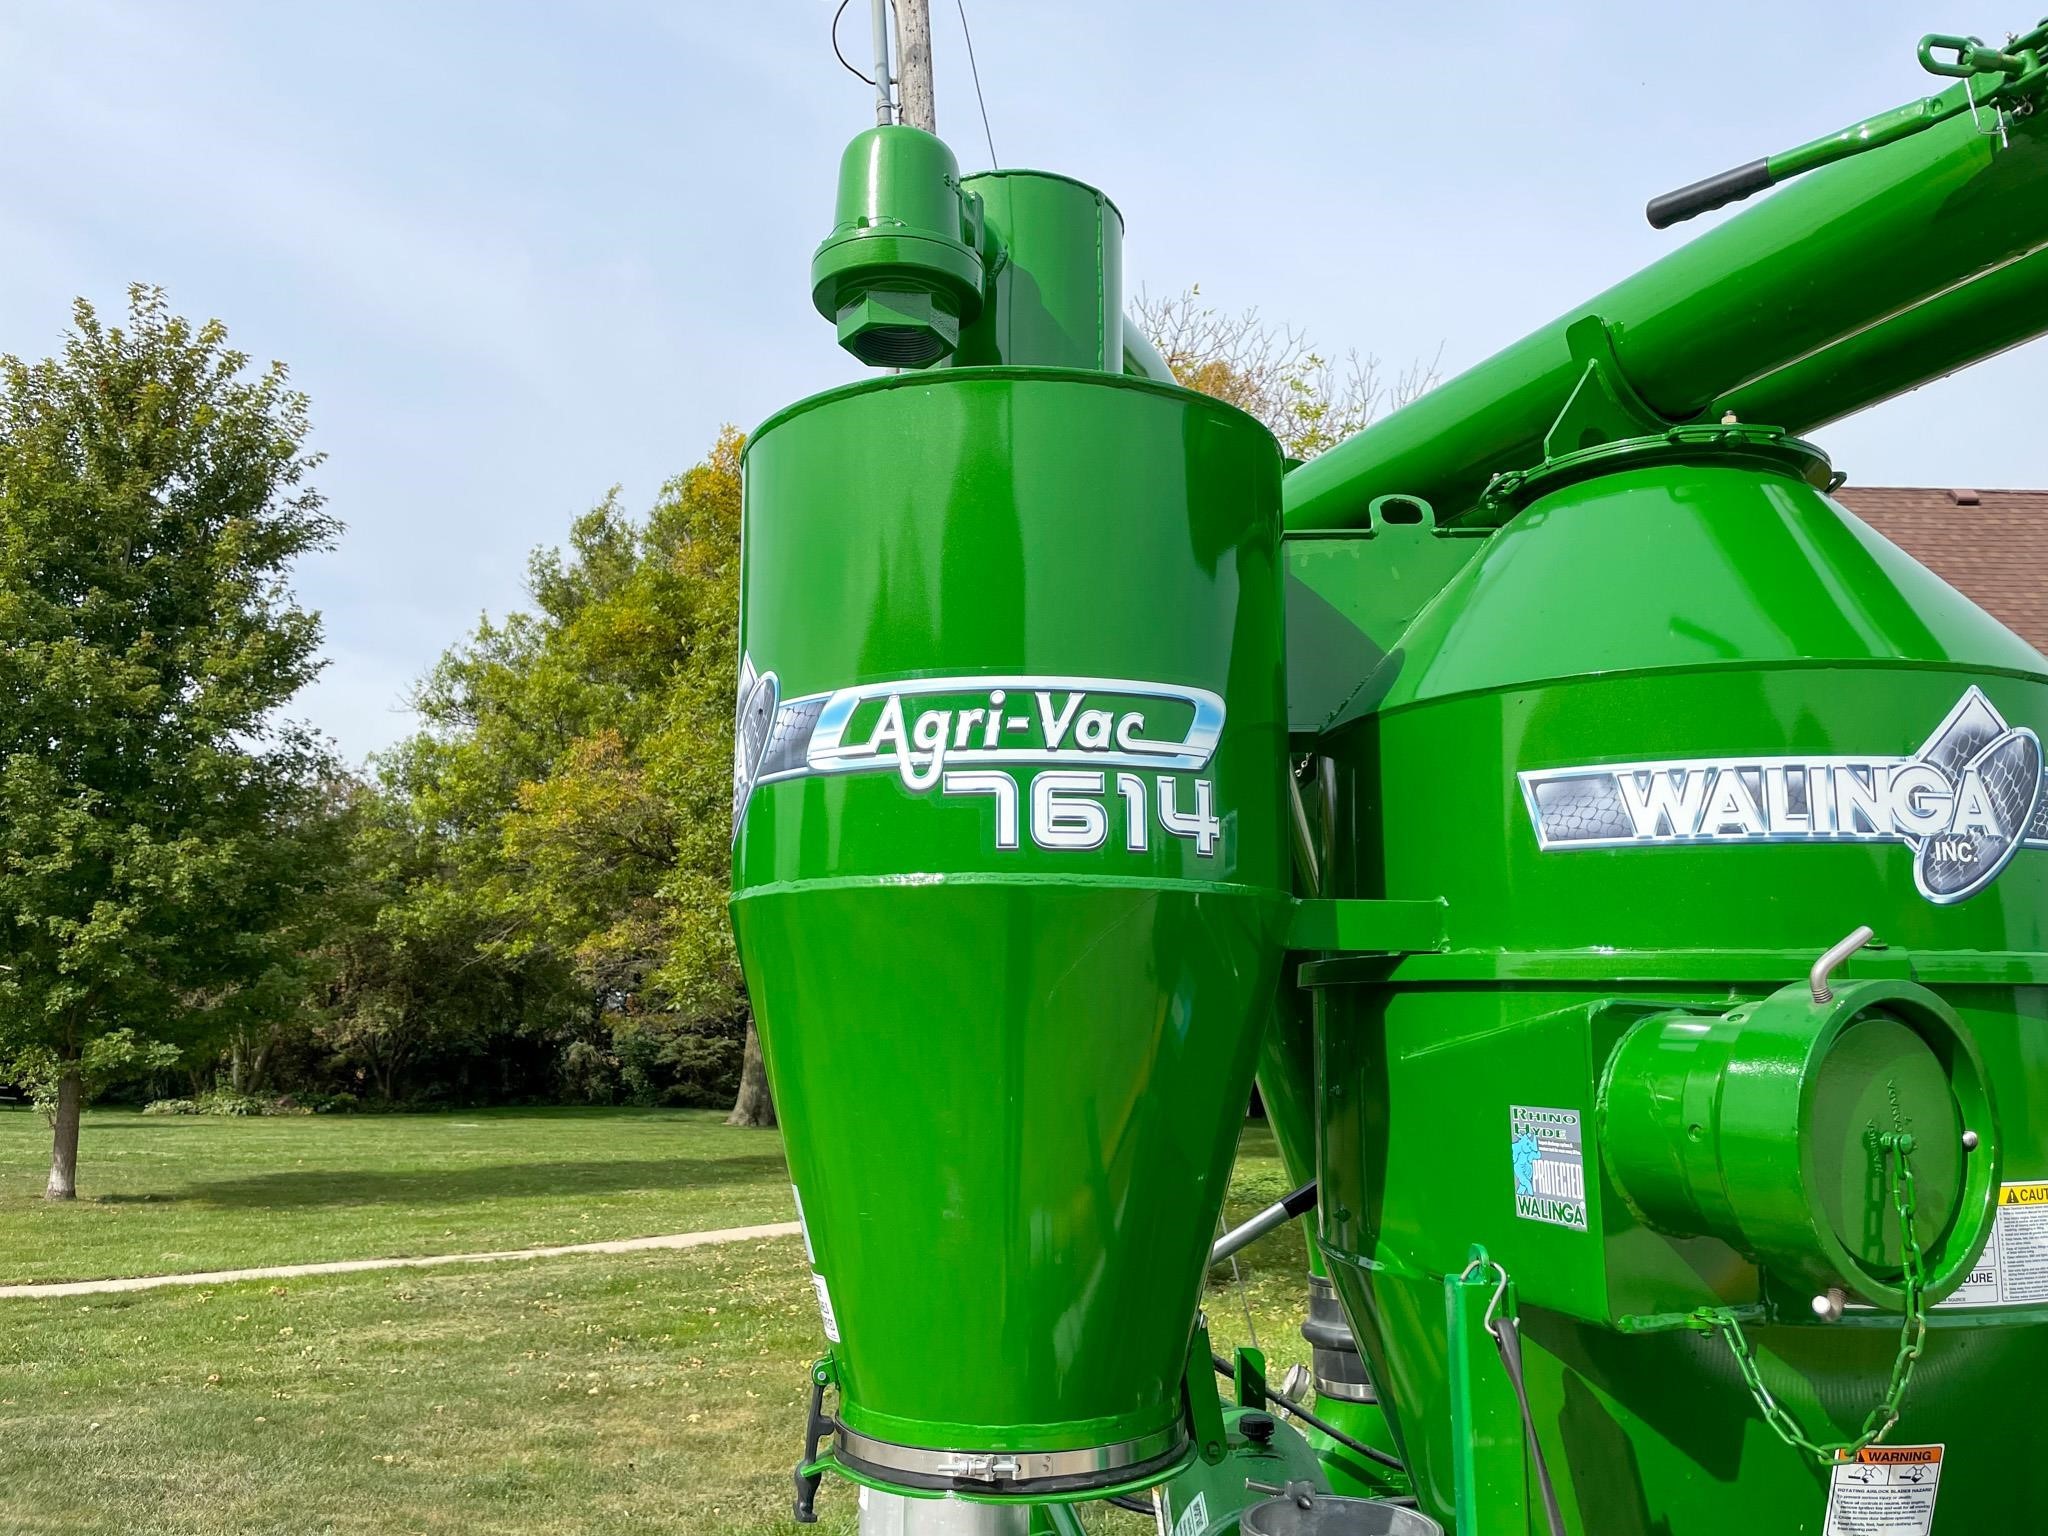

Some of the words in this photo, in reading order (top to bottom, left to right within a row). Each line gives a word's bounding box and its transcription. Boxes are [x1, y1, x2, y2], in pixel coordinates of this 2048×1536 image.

[866, 690, 1146, 790] Agri-Vac
[942, 771, 1221, 856] 7614
[1613, 763, 2004, 839] WALINGA
[1934, 841, 1979, 864] INC.
[1513, 1107, 1577, 1125] RHINO
[1532, 1159, 1584, 1199] PROTECTED
[1517, 1195, 1585, 1226] WALINGA
[1868, 1450, 1932, 1462] WARNING
